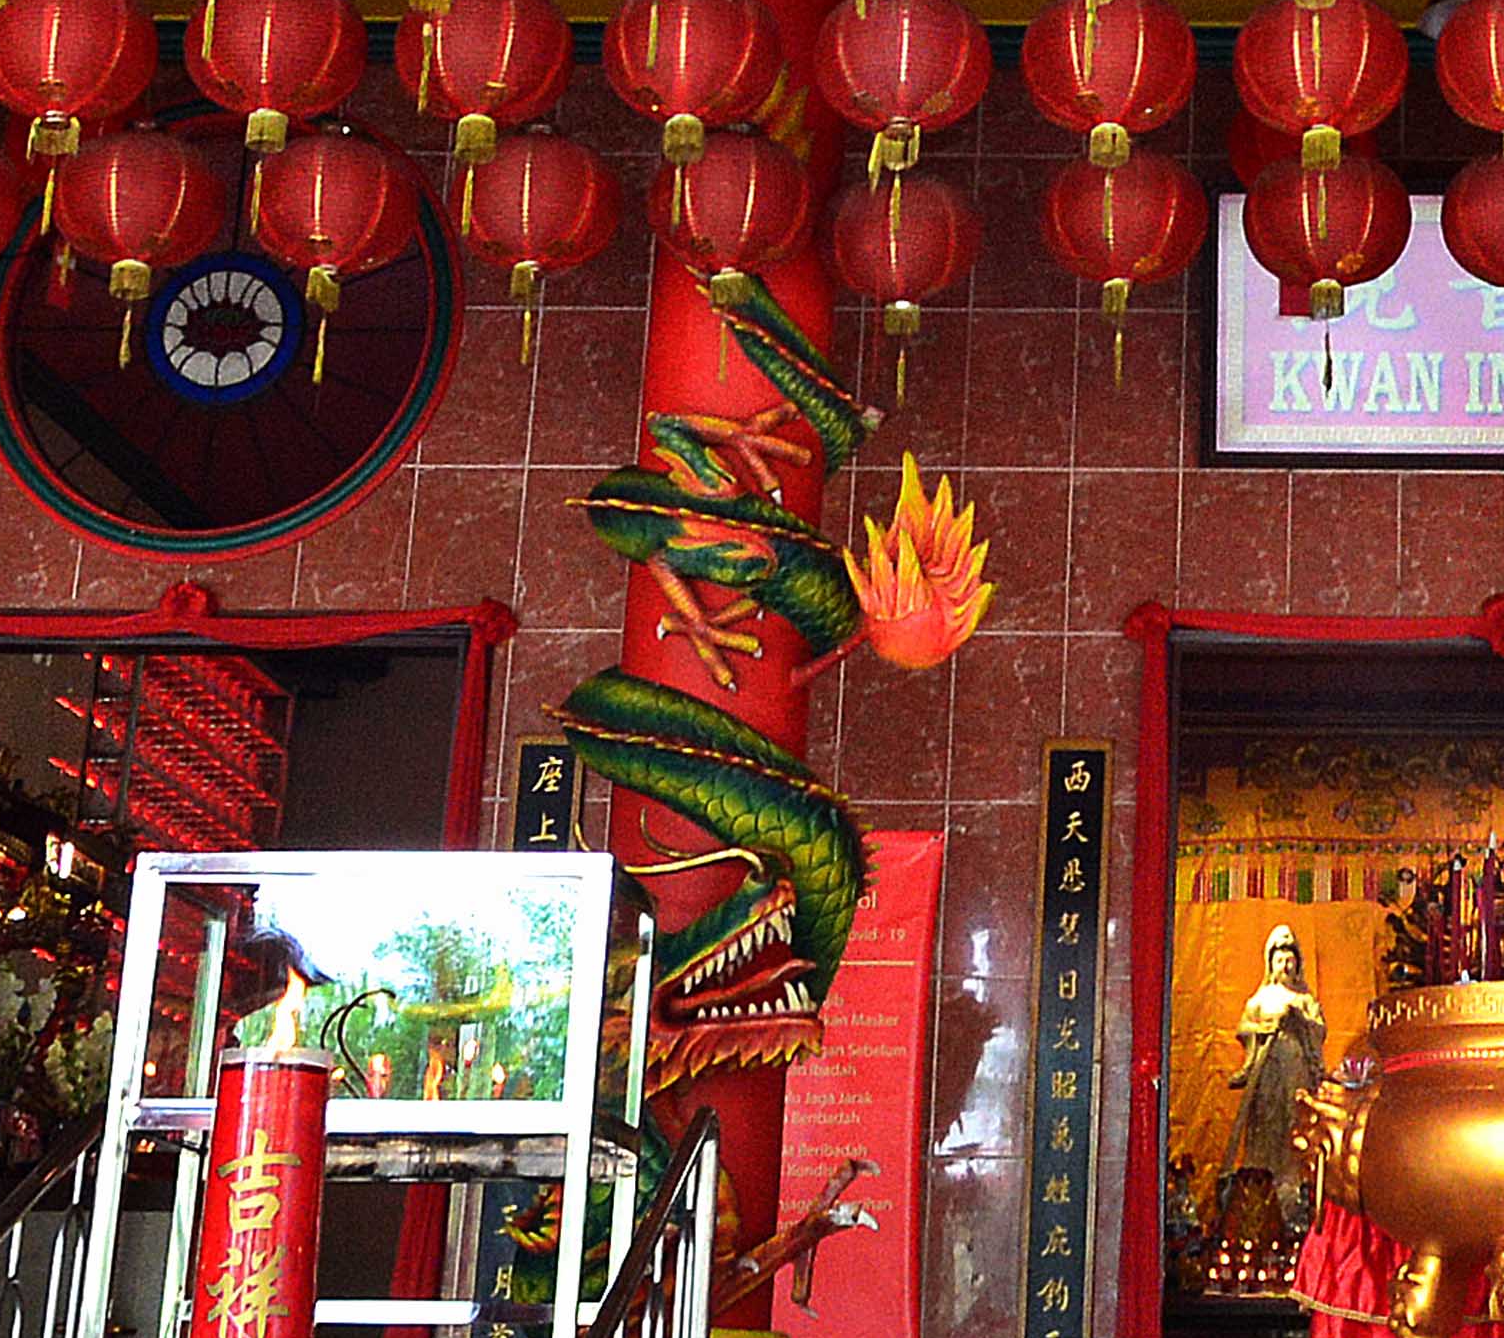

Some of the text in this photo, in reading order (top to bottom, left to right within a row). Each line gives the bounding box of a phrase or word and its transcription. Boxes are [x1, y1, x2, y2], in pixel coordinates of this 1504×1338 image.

[1269, 351, 1442, 415] KWAN
[848, 927, 878, 941] ovid
[891, 928, 907, 941] 19
